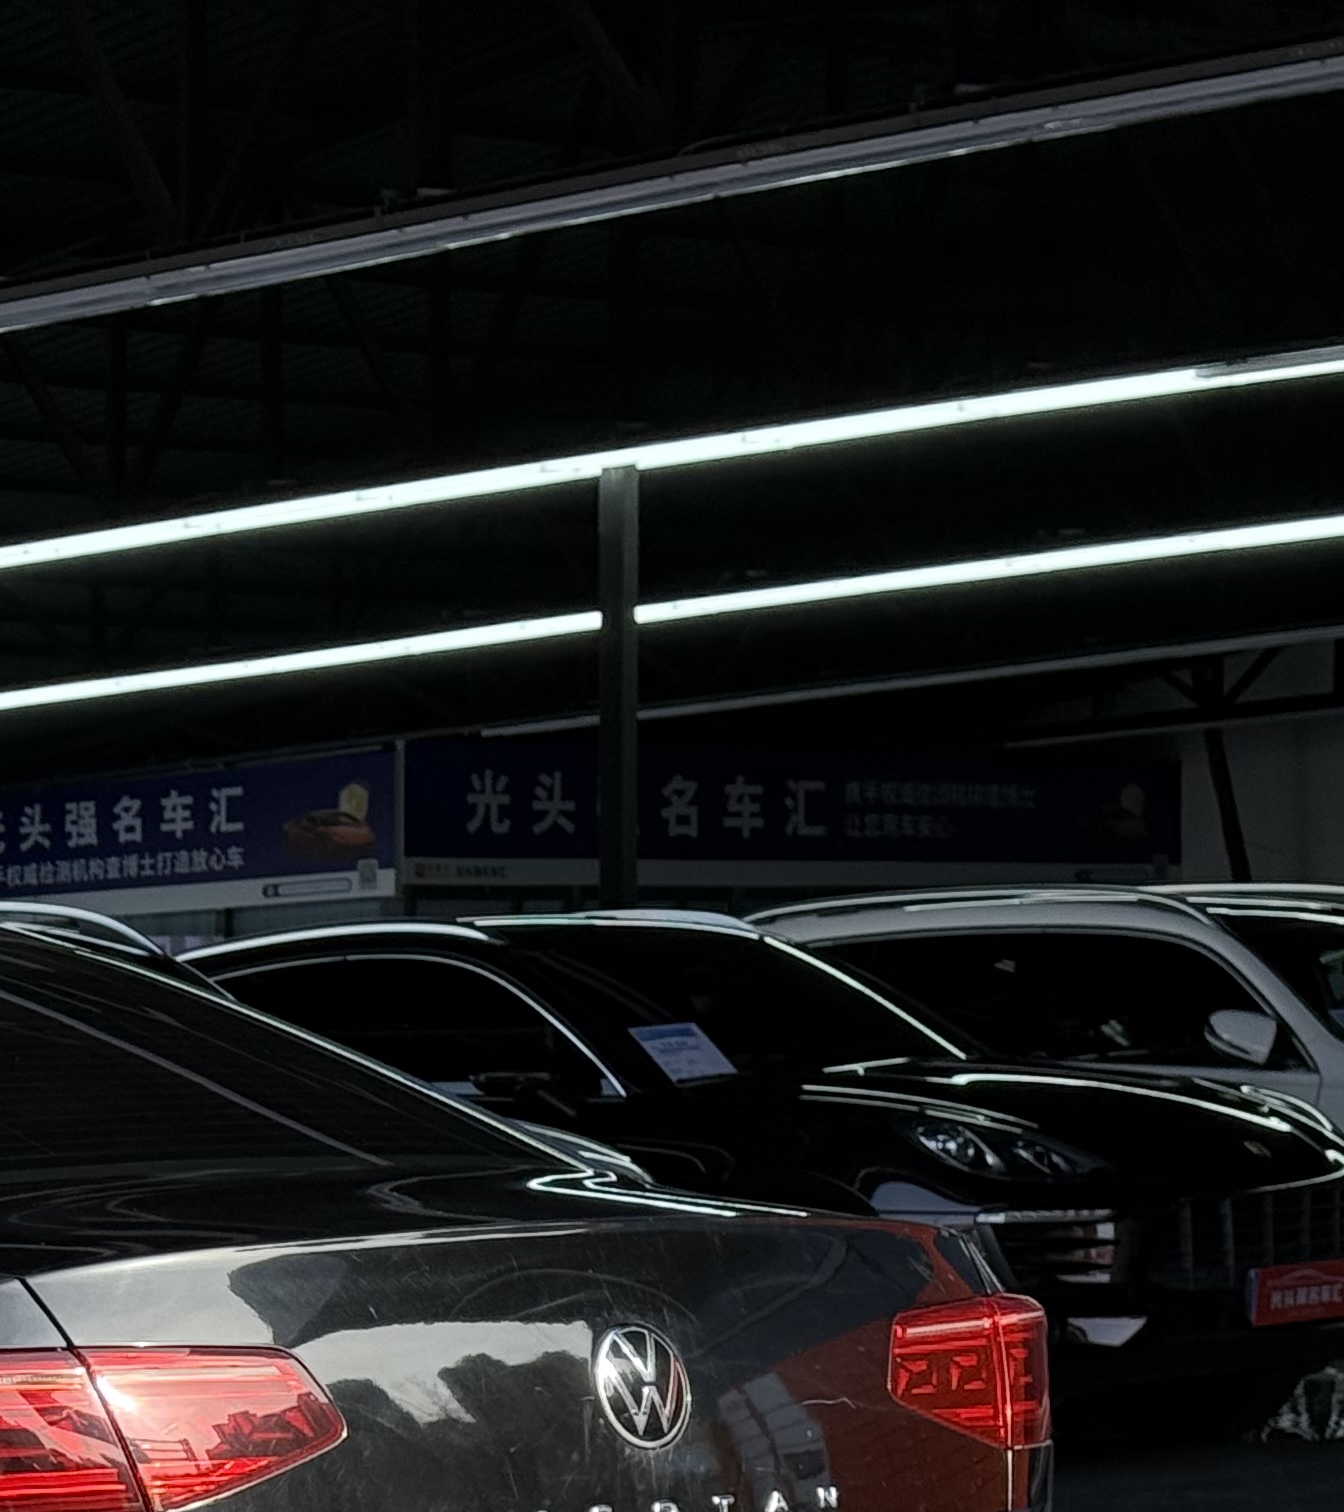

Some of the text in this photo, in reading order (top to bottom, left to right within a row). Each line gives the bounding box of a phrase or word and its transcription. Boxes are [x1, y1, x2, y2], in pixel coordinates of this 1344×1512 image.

[464, 767, 829, 840] 光头名车汇
